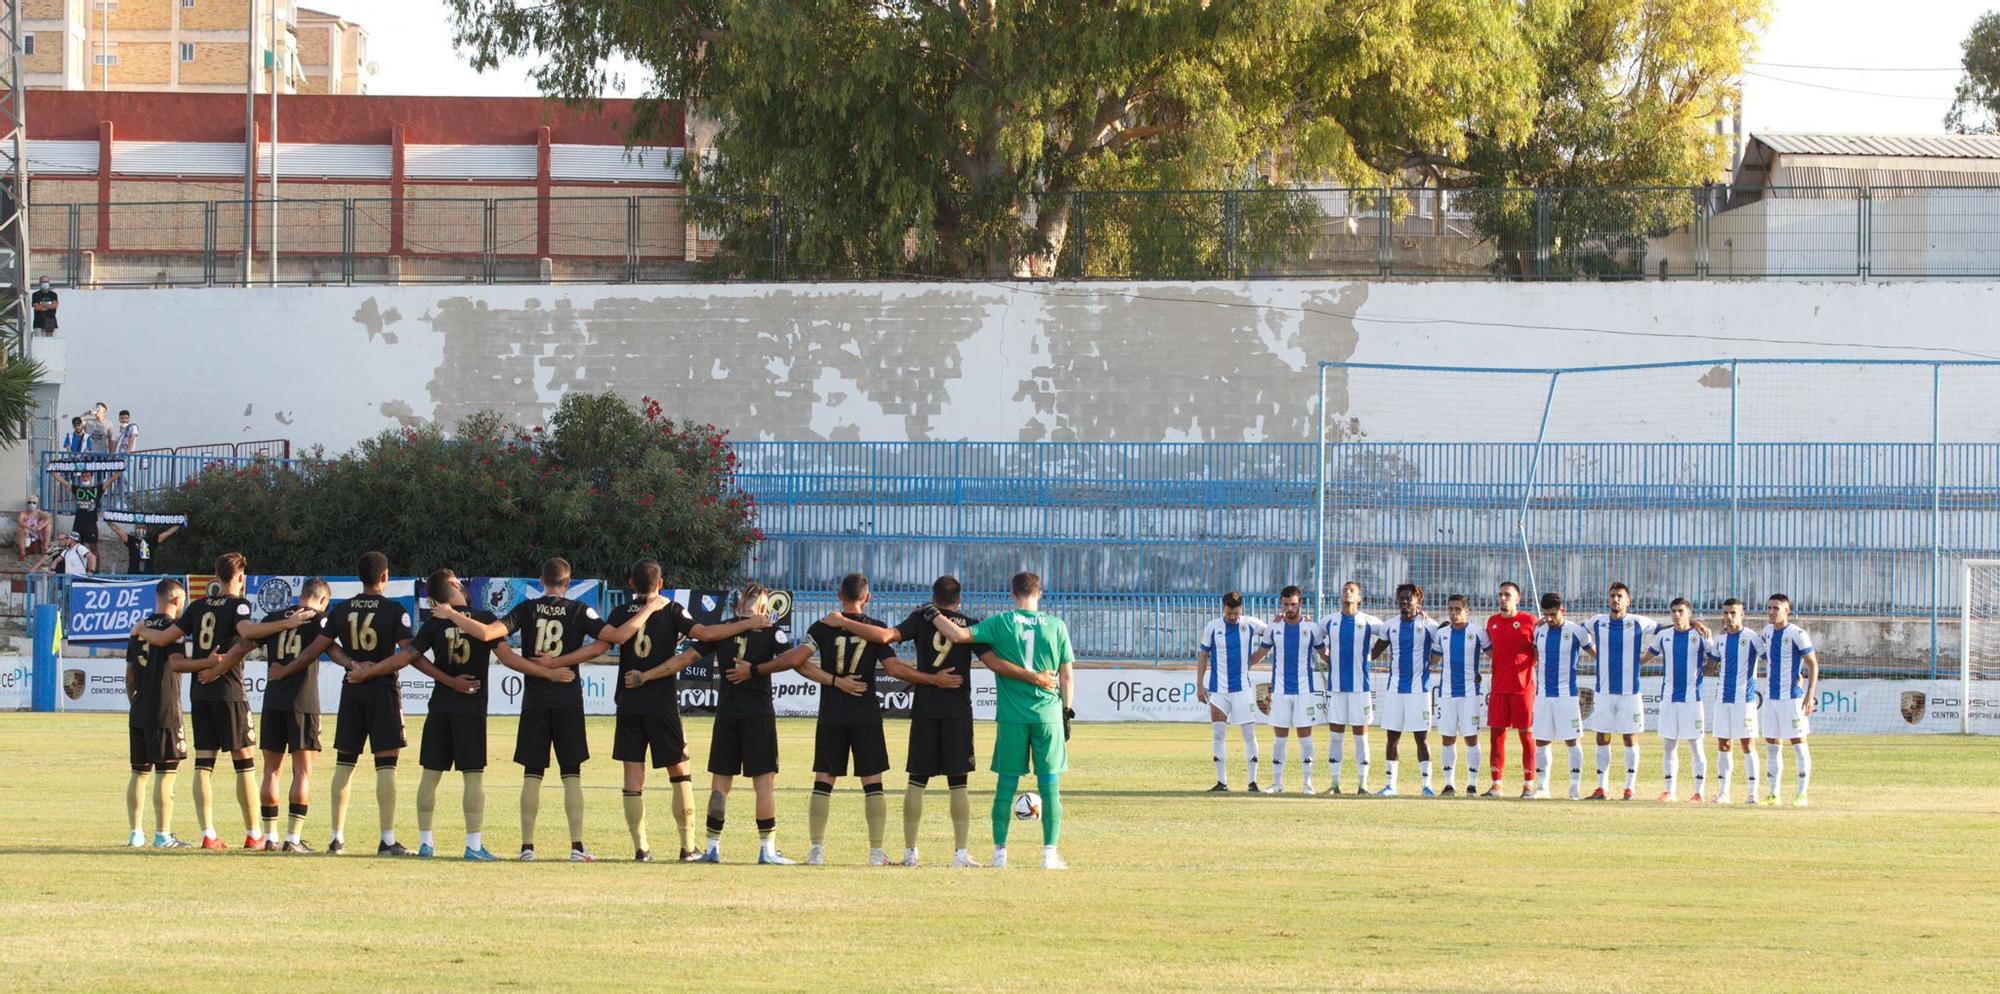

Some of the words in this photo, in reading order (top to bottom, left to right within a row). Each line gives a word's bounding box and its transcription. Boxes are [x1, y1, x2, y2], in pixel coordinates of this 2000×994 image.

[104, 511, 134, 522] ULTRAS
[85, 590, 111, 609] 20
[116, 588, 142, 608] DE
[199, 611, 216, 650] 8
[277, 628, 302, 660] 14
[347, 611, 378, 651] 16
[445, 626, 471, 665] 15
[535, 618, 564, 658] 18
[634, 622, 652, 658] 6
[932, 630, 954, 668] 9
[834, 635, 868, 674] 17
[1022, 629, 1036, 672] 1
[685, 666, 708, 677] SUR
[1931, 711, 1959, 719] CENTRO
